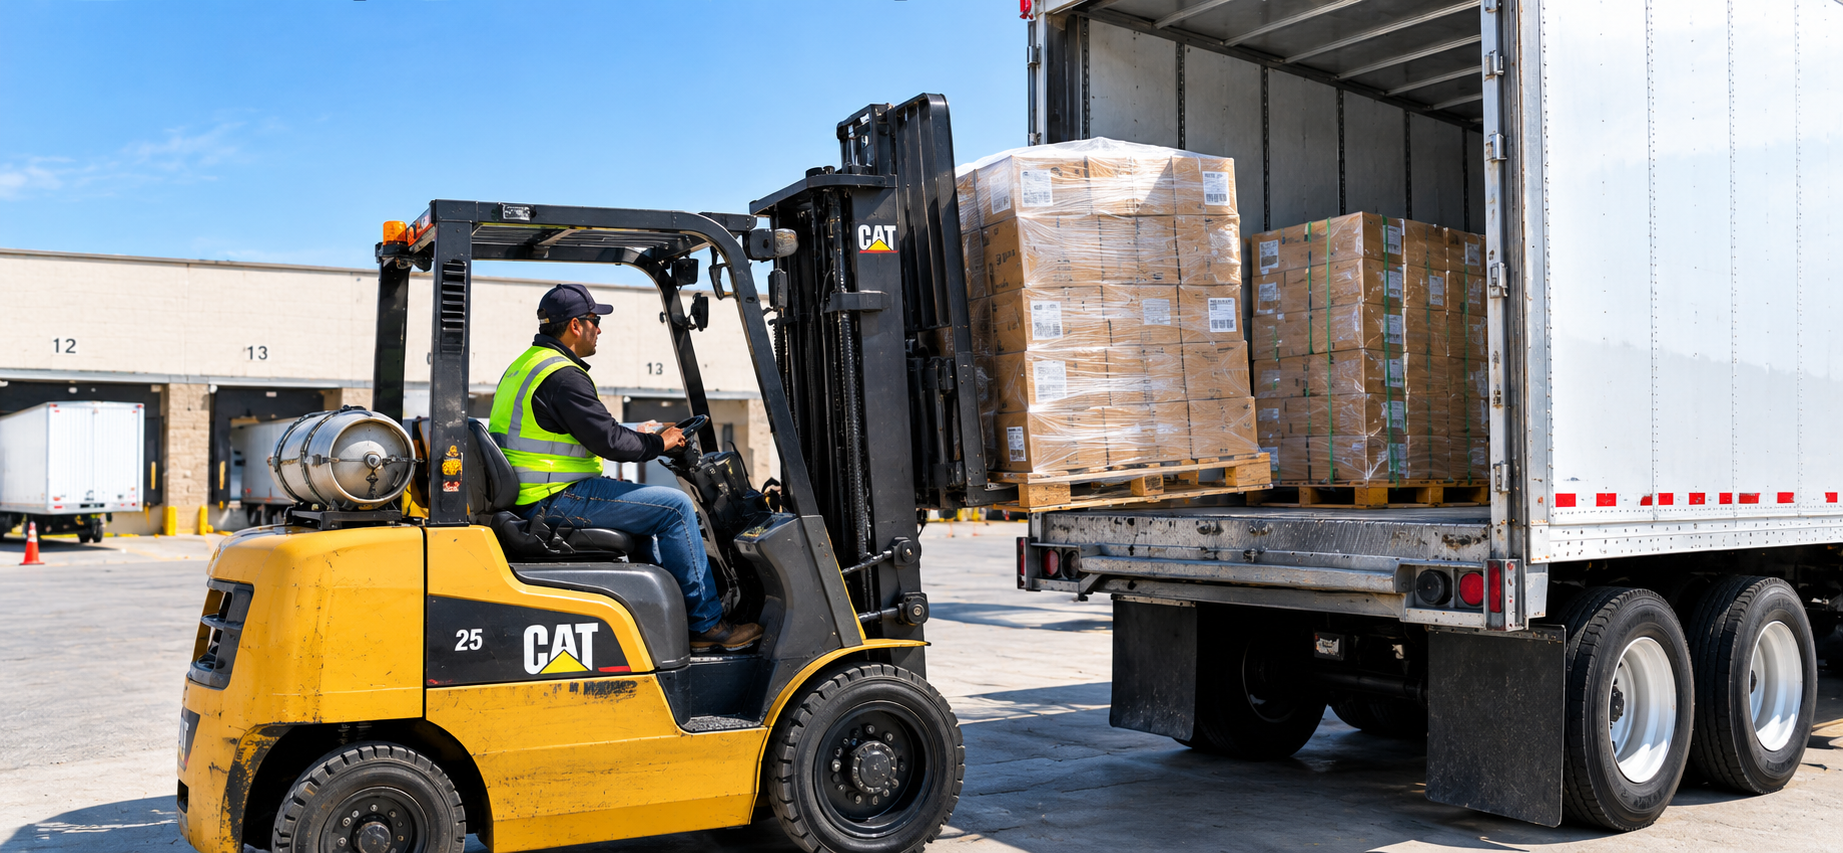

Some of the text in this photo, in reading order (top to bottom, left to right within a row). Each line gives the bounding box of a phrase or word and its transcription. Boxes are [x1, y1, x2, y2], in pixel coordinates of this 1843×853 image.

[858, 224, 897, 251] CAT
[53, 338, 77, 354] 12
[247, 345, 268, 360] 13
[646, 362, 663, 375] 13
[455, 628, 483, 651] 25
[523, 622, 599, 675] CAT
